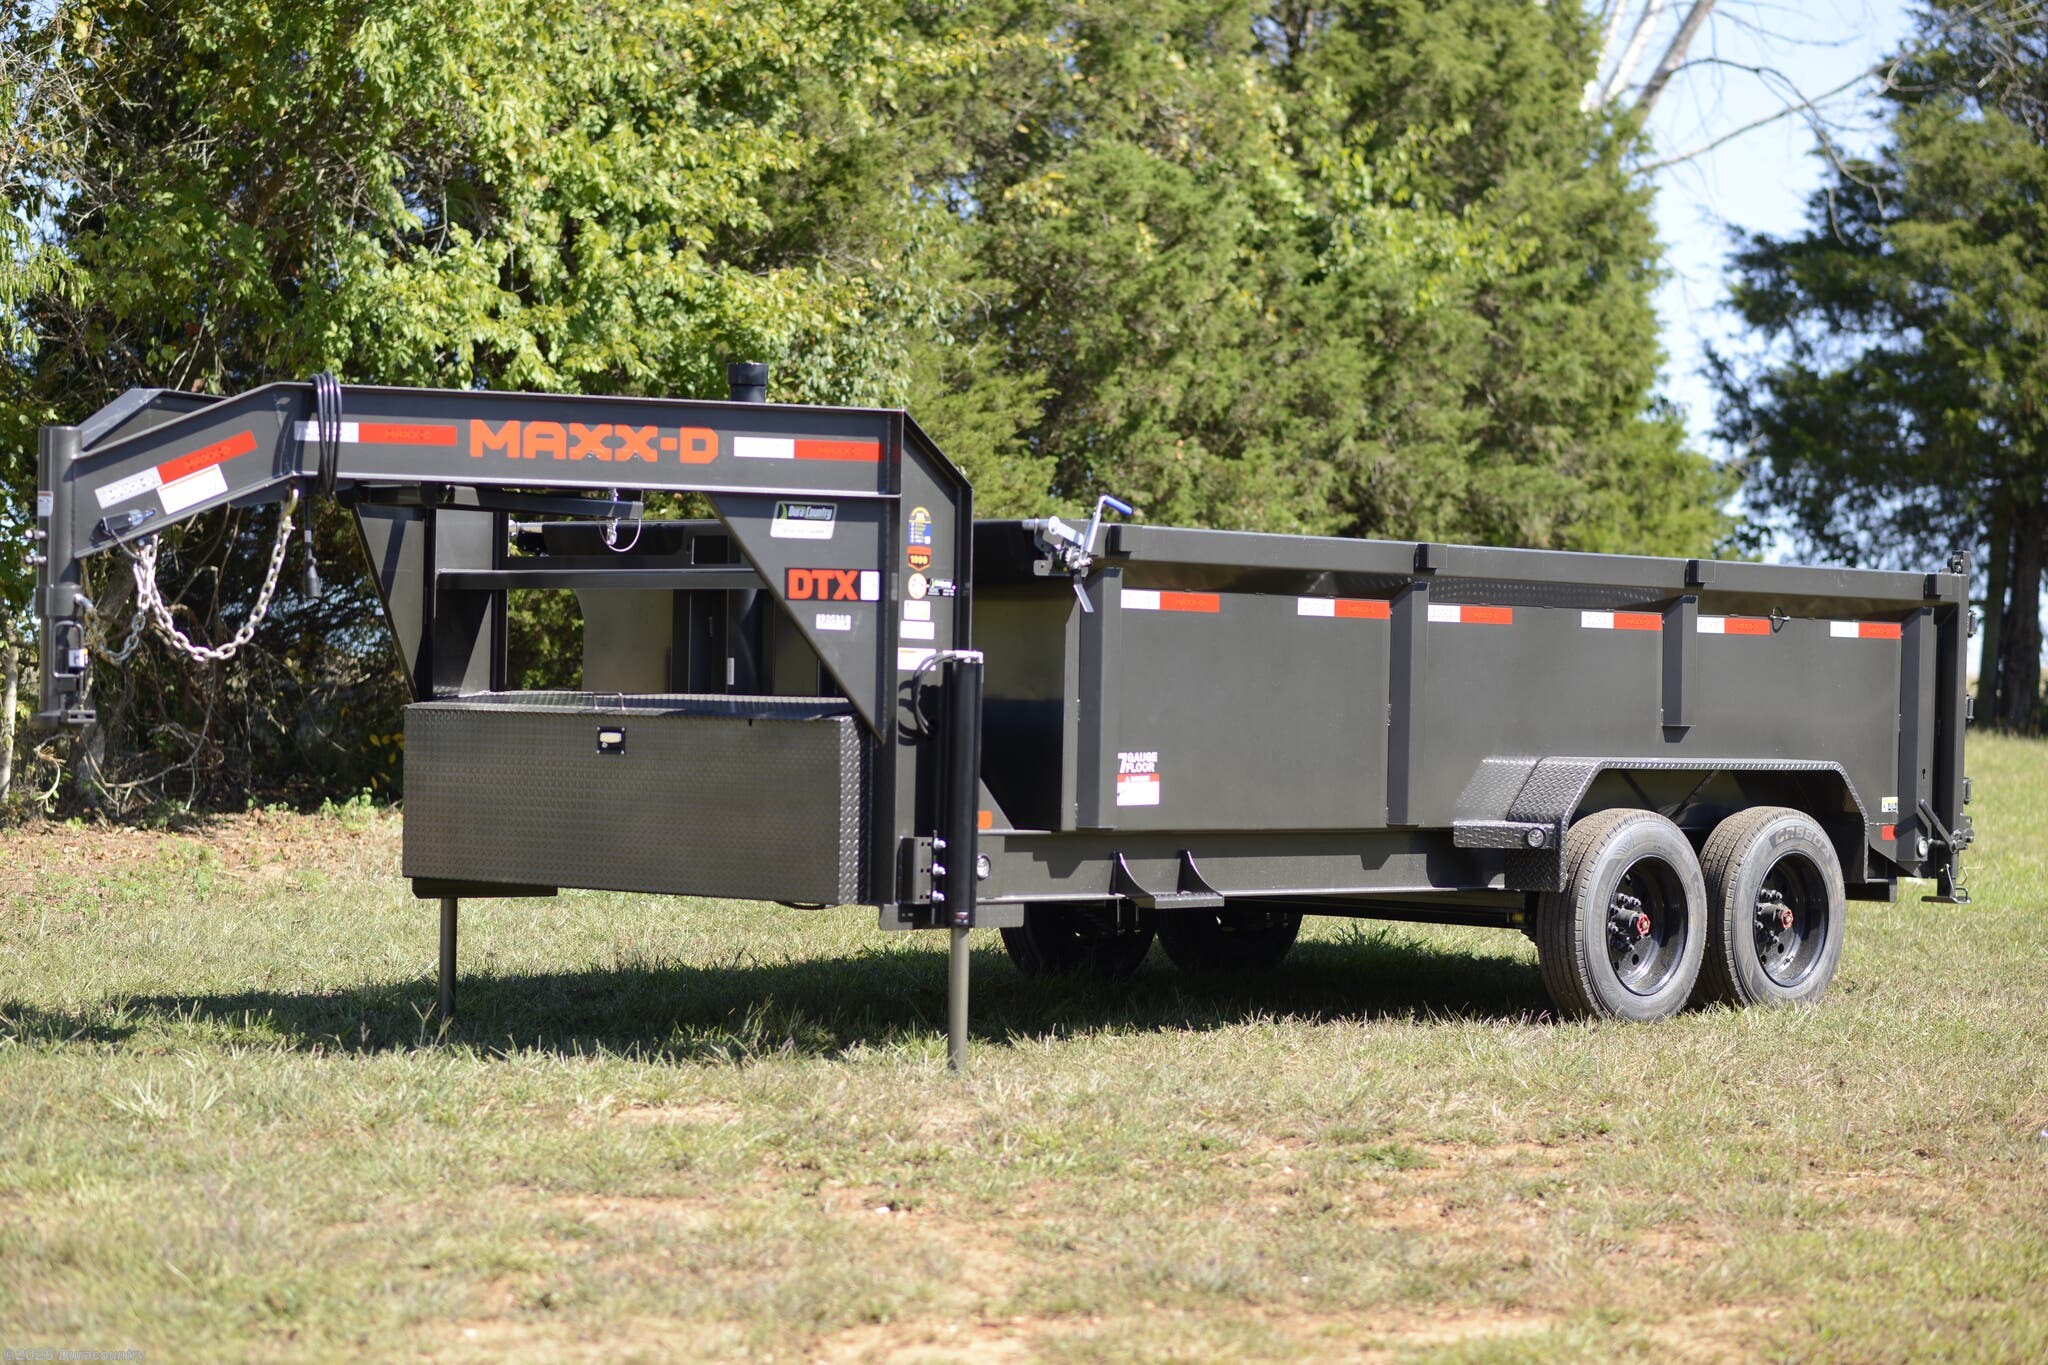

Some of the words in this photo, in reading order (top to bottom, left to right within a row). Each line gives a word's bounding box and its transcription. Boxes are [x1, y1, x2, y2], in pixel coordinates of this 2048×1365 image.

[470, 419, 718, 464] MAXX-D
[788, 569, 858, 600] DTX
[1117, 752, 1128, 773] 7
[1127, 751, 1158, 763] GAUGE
[1126, 762, 1156, 773] FLOOR
